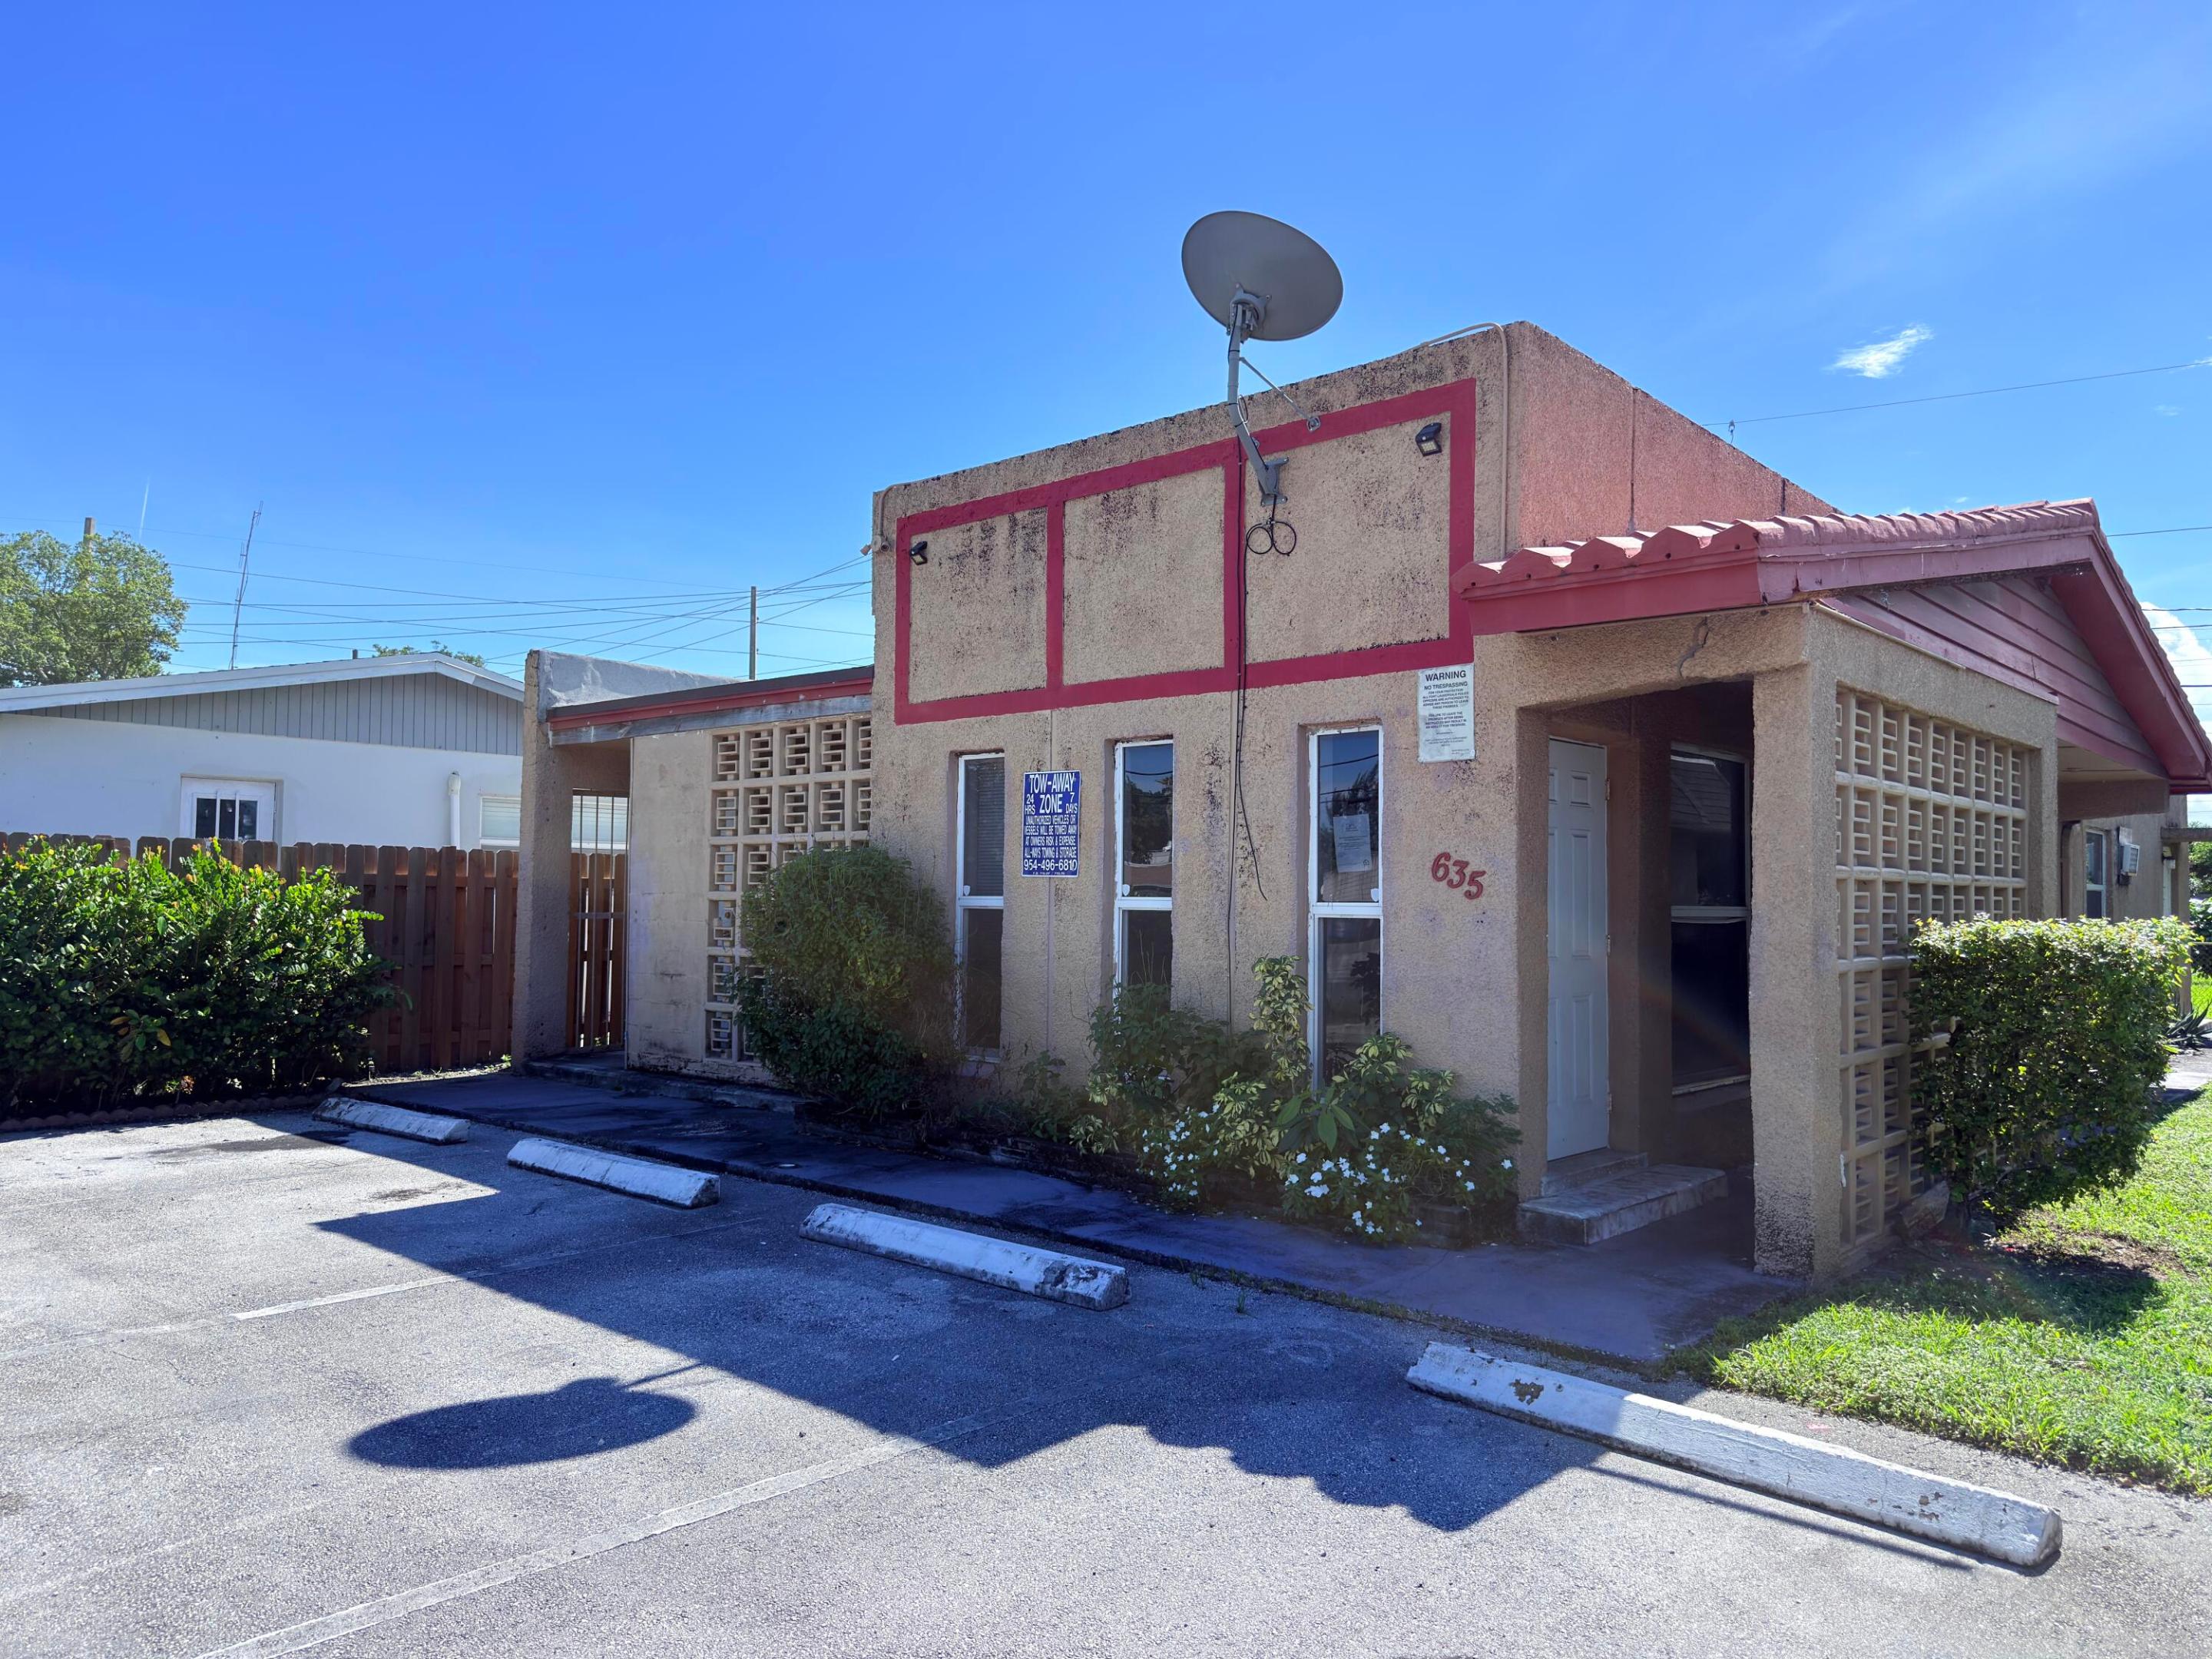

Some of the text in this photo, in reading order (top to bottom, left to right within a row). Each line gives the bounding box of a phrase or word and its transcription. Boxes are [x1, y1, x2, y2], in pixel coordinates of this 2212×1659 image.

[1426, 670, 1466, 682] WARNING
[1029, 773, 1075, 793] TOW-AWAY
[1026, 794, 1034, 804] 24
[1070, 793, 1075, 803] 7
[1039, 794, 1063, 813] ZONE
[1065, 803, 1078, 813] DAYS
[1025, 805, 1035, 815] HRS
[1026, 816, 1051, 825] UNAUTHORIZED
[1052, 815, 1069, 824] VEHICLES
[1048, 826, 1054, 835] BE
[1055, 826, 1066, 835] TOWED
[1059, 836, 1075, 846] EXPENSE
[1060, 847, 1077, 858] STORAGE
[1024, 859, 1078, 871] 954-496-6810
[1431, 851, 1486, 900] 635
